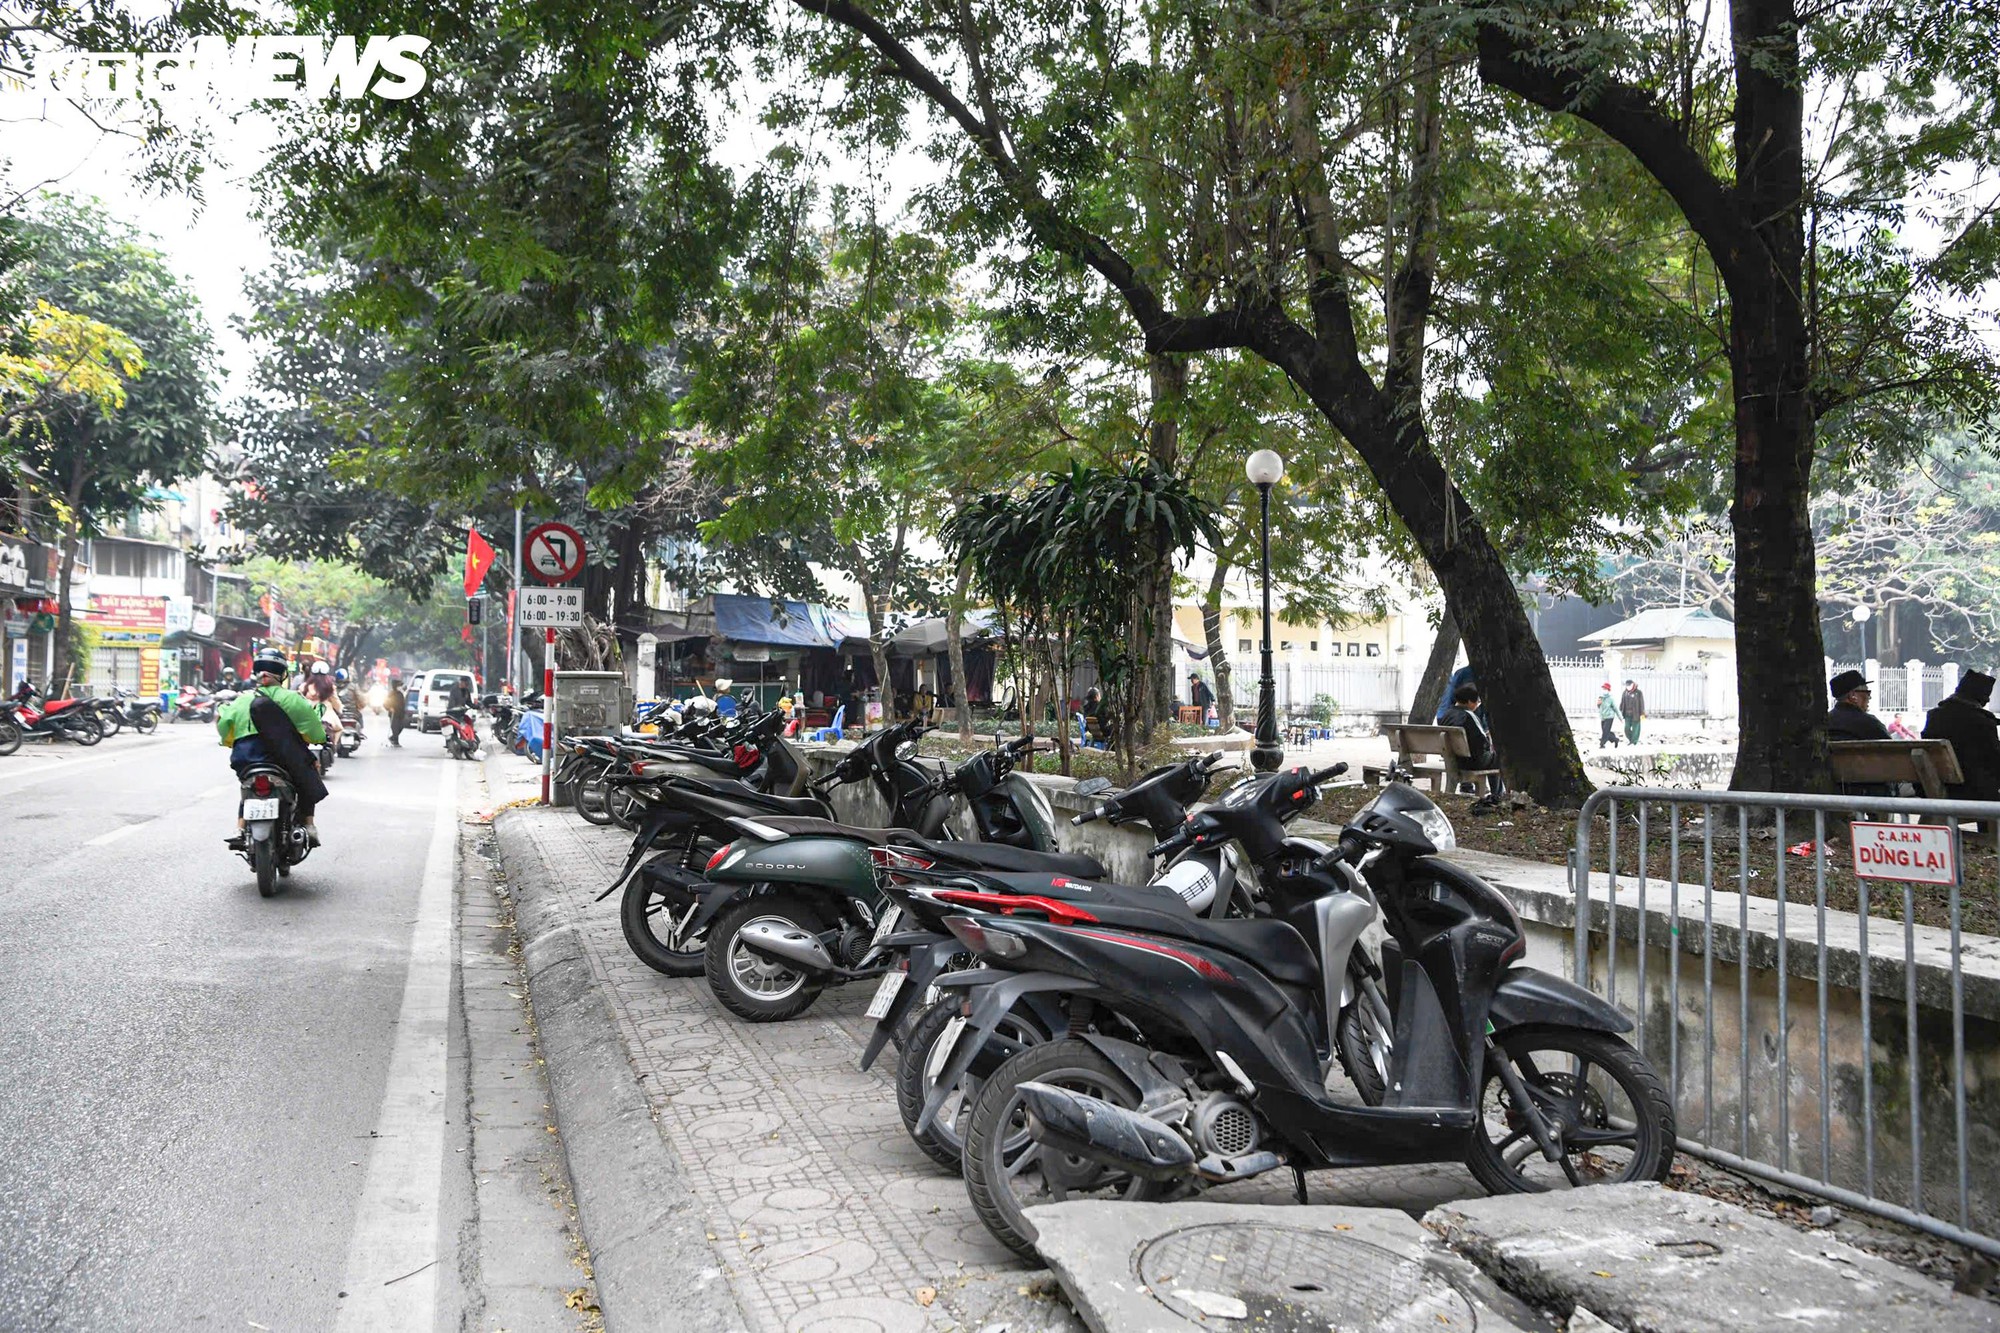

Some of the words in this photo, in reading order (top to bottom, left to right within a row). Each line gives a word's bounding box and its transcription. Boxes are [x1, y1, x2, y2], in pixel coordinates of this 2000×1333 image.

[527, 594, 547, 605] 6:00
[557, 595, 577, 606] 9:00
[522, 610, 546, 621] 16:00
[556, 611, 580, 622] 19:30
[1877, 830, 1922, 843] C.A.H.N
[1860, 842, 1910, 867] DỪNG
[1913, 850, 1946, 872] LẠI
[745, 862, 806, 870] SCOOPY
